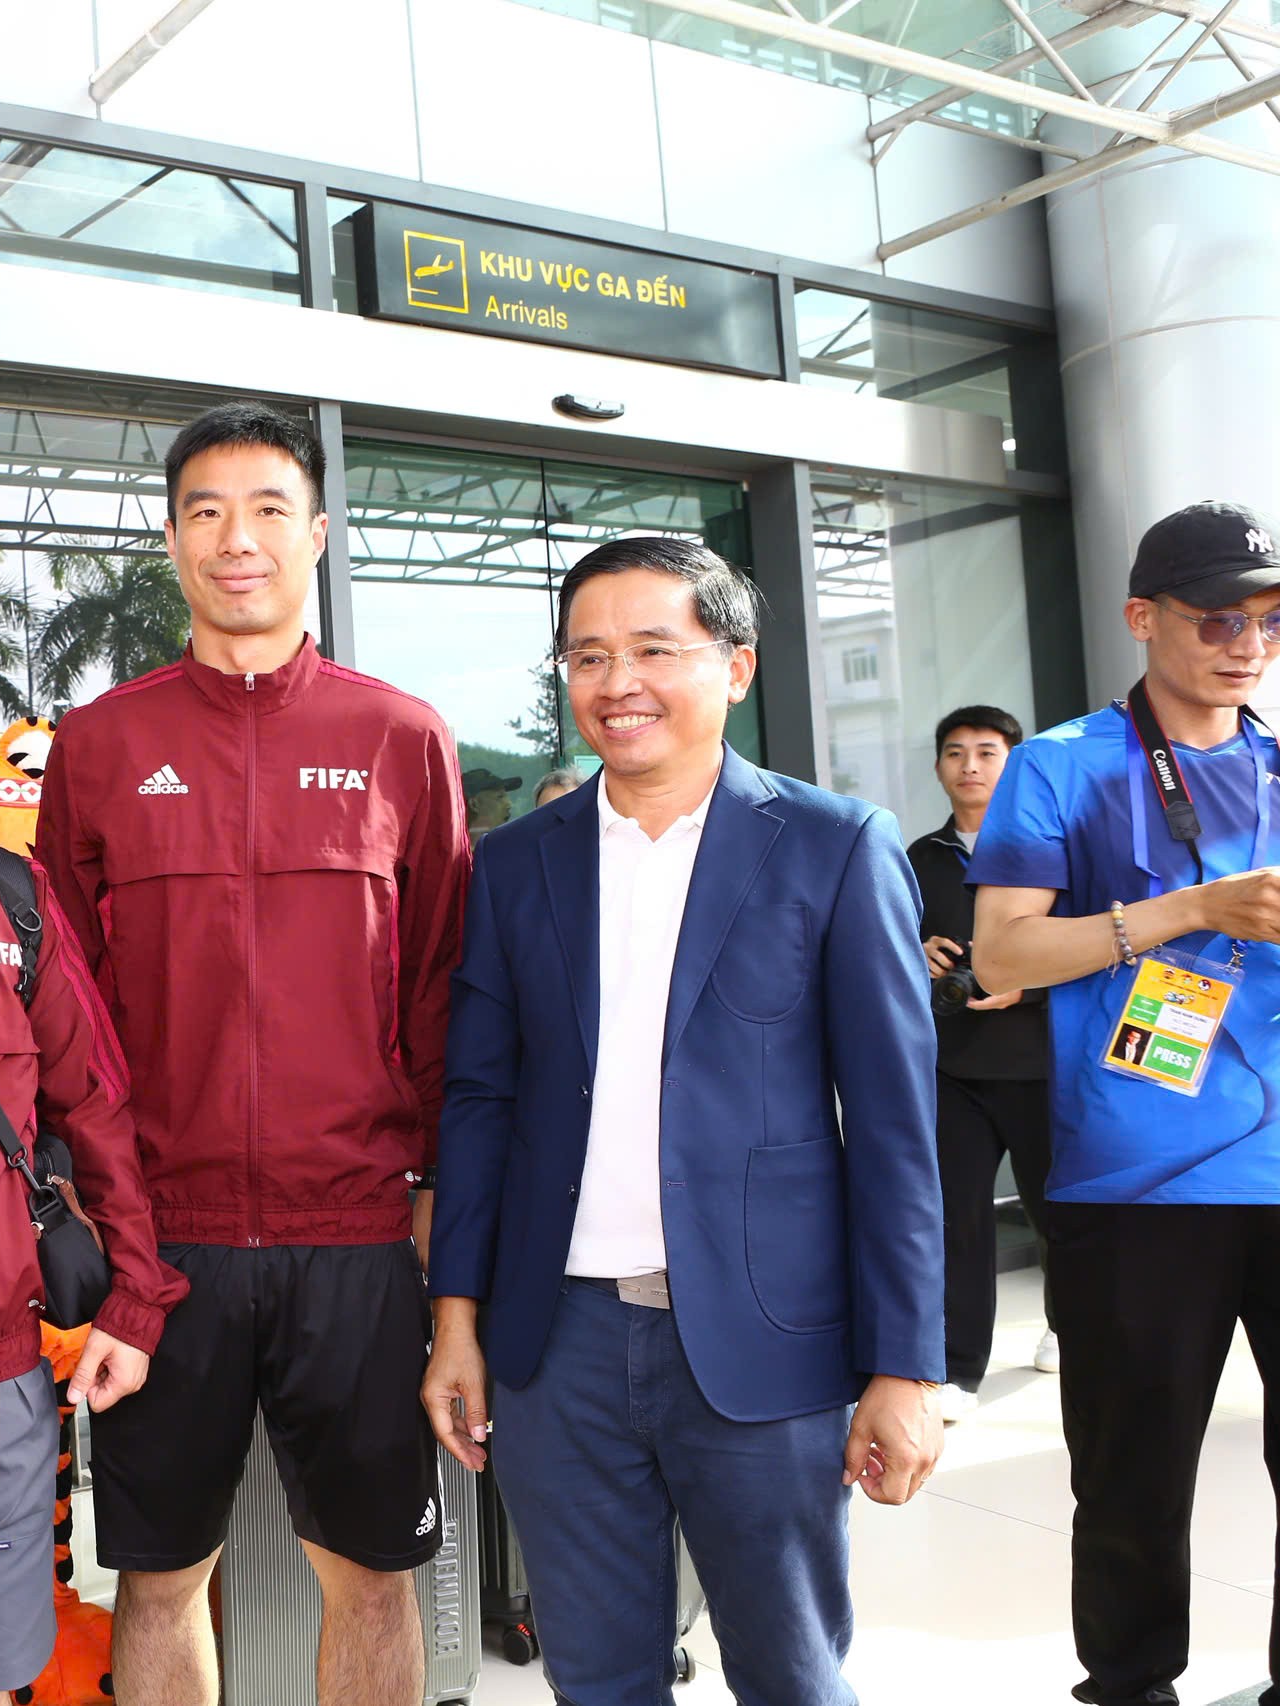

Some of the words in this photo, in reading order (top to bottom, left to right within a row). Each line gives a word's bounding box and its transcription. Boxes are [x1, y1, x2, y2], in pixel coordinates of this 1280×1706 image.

[479, 250, 533, 283] KHU
[538, 261, 590, 293] VỰC
[597, 273, 631, 300] GA
[637, 275, 687, 309] ĐẾN
[485, 295, 569, 330] Arrivals
[299, 767, 367, 791] FIFA
[1152, 749, 1177, 791] Canon
[137, 783, 189, 795] adidas
[1152, 1046, 1193, 1069] PRESS
